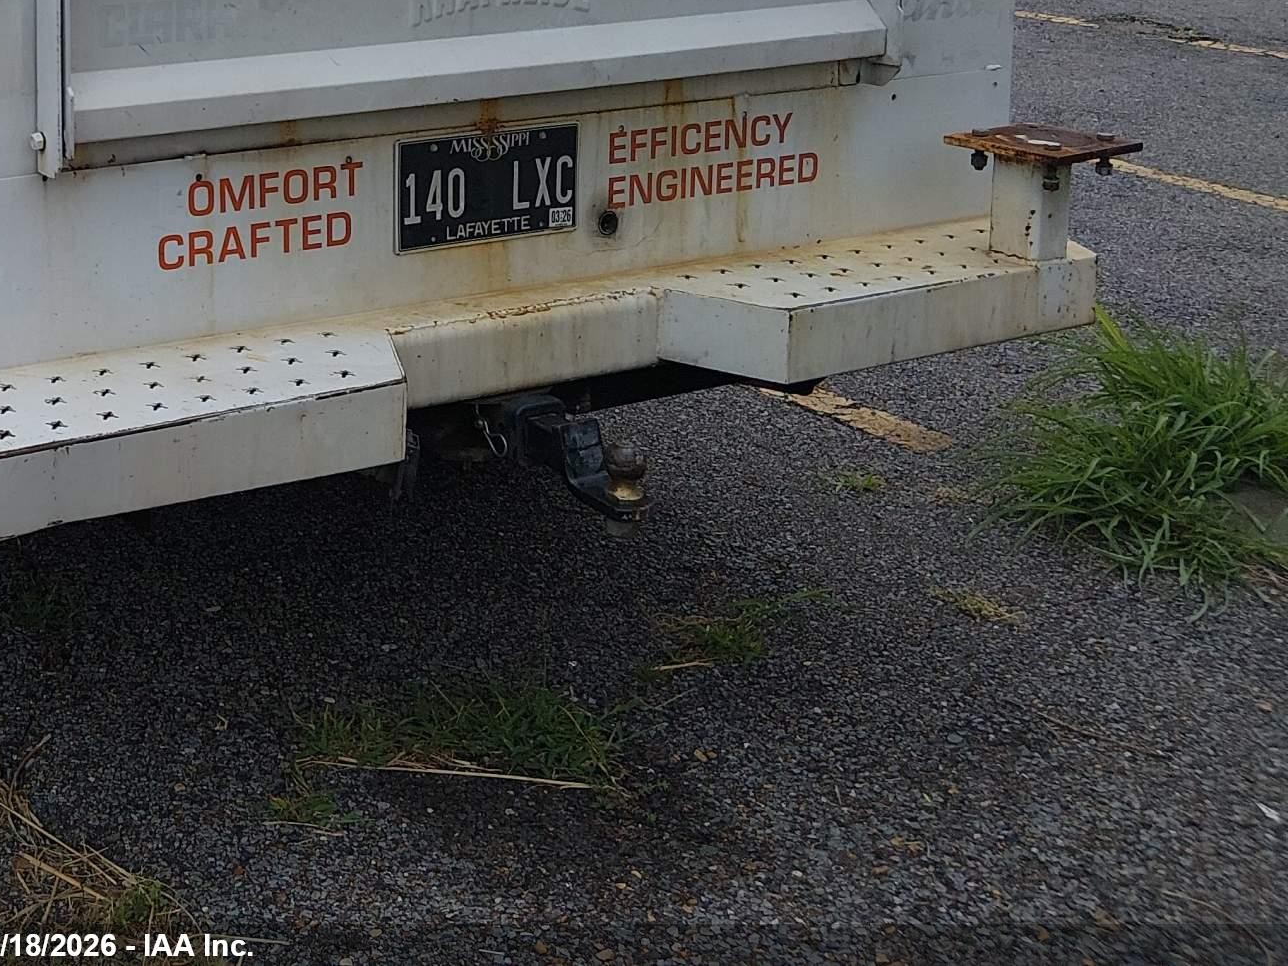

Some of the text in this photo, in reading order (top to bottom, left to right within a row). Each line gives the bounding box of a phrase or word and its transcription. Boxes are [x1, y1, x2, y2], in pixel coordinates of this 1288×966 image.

[608, 112, 794, 165] EFFICENCY
[187, 160, 364, 217] OMFORT
[403, 154, 574, 226] 140 LXC
[607, 151, 819, 210] ENGINEERED
[157, 210, 353, 272] CRAFTED
[446, 215, 532, 241] LAFAYETTE
